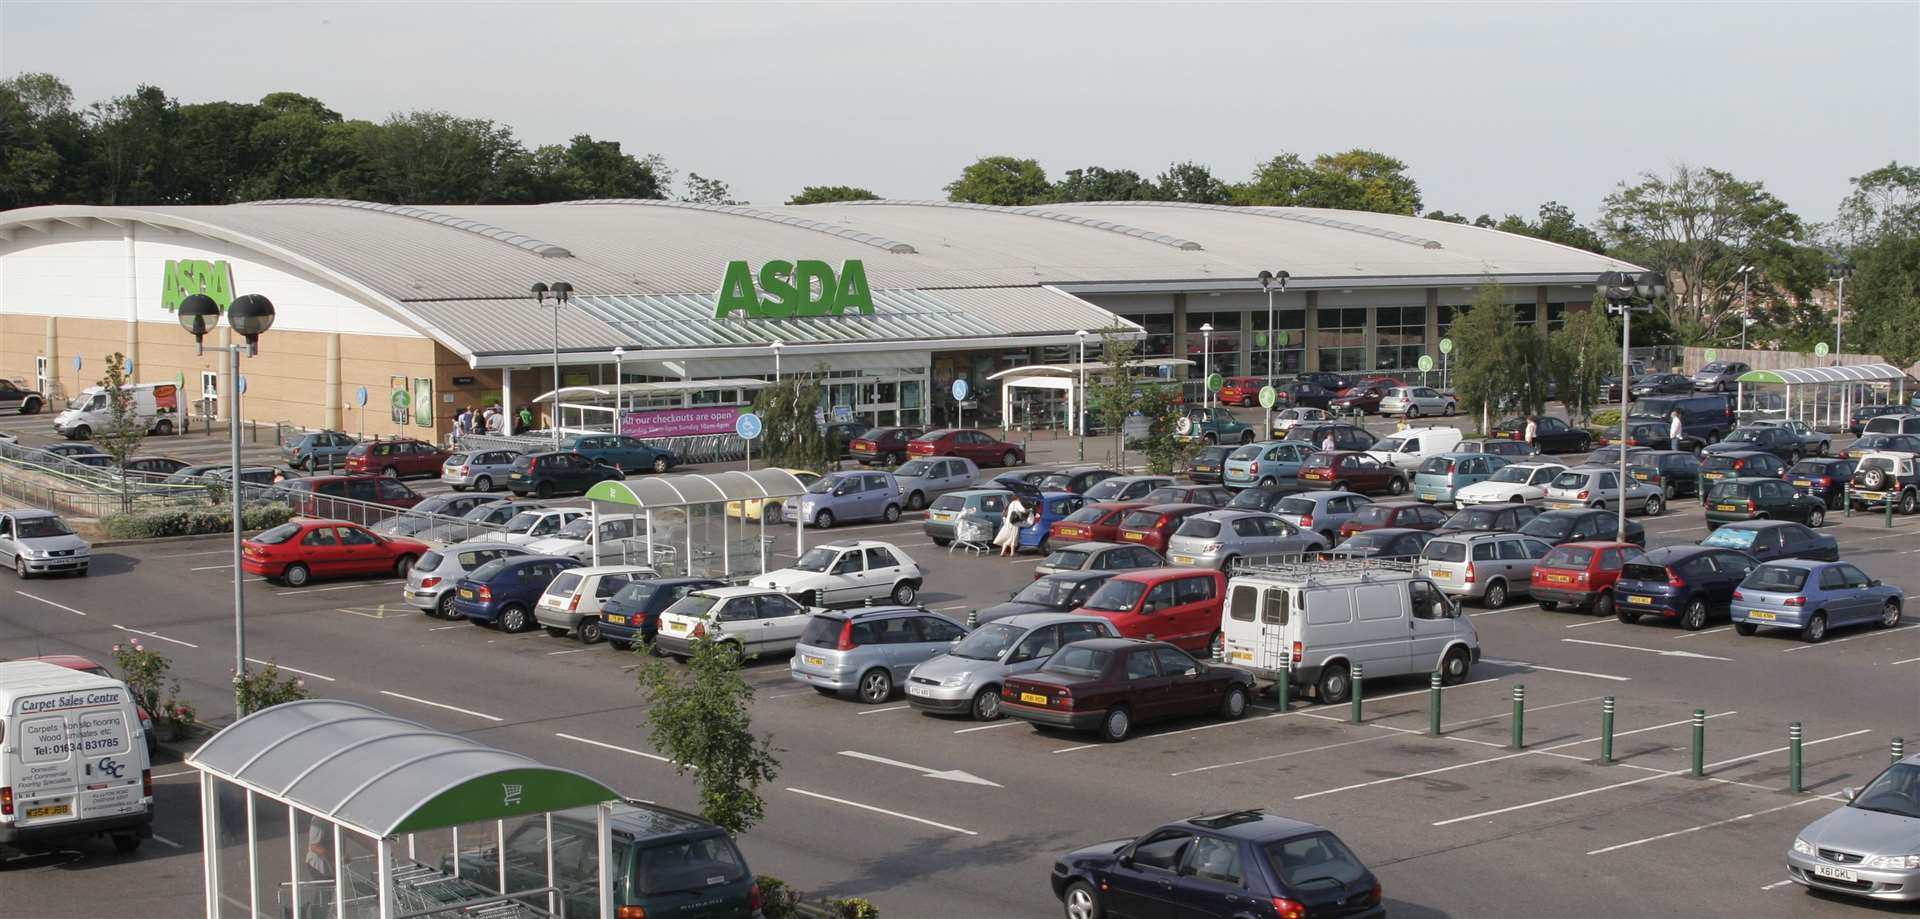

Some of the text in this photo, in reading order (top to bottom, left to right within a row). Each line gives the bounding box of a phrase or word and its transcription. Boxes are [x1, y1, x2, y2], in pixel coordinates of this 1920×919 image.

[161, 259, 233, 312] ASDA
[715, 259, 876, 319] ASDA
[622, 415, 634, 425] All
[652, 412, 694, 423] checkouts
[696, 413, 709, 421] are
[22, 693, 119, 712] Carpet Sales Centre
[28, 724, 58, 735] Carpets
[93, 717, 121, 727] flooring
[39, 735, 62, 743] Wood
[85, 738, 119, 751] 831785
[98, 757, 126, 778] CSC
